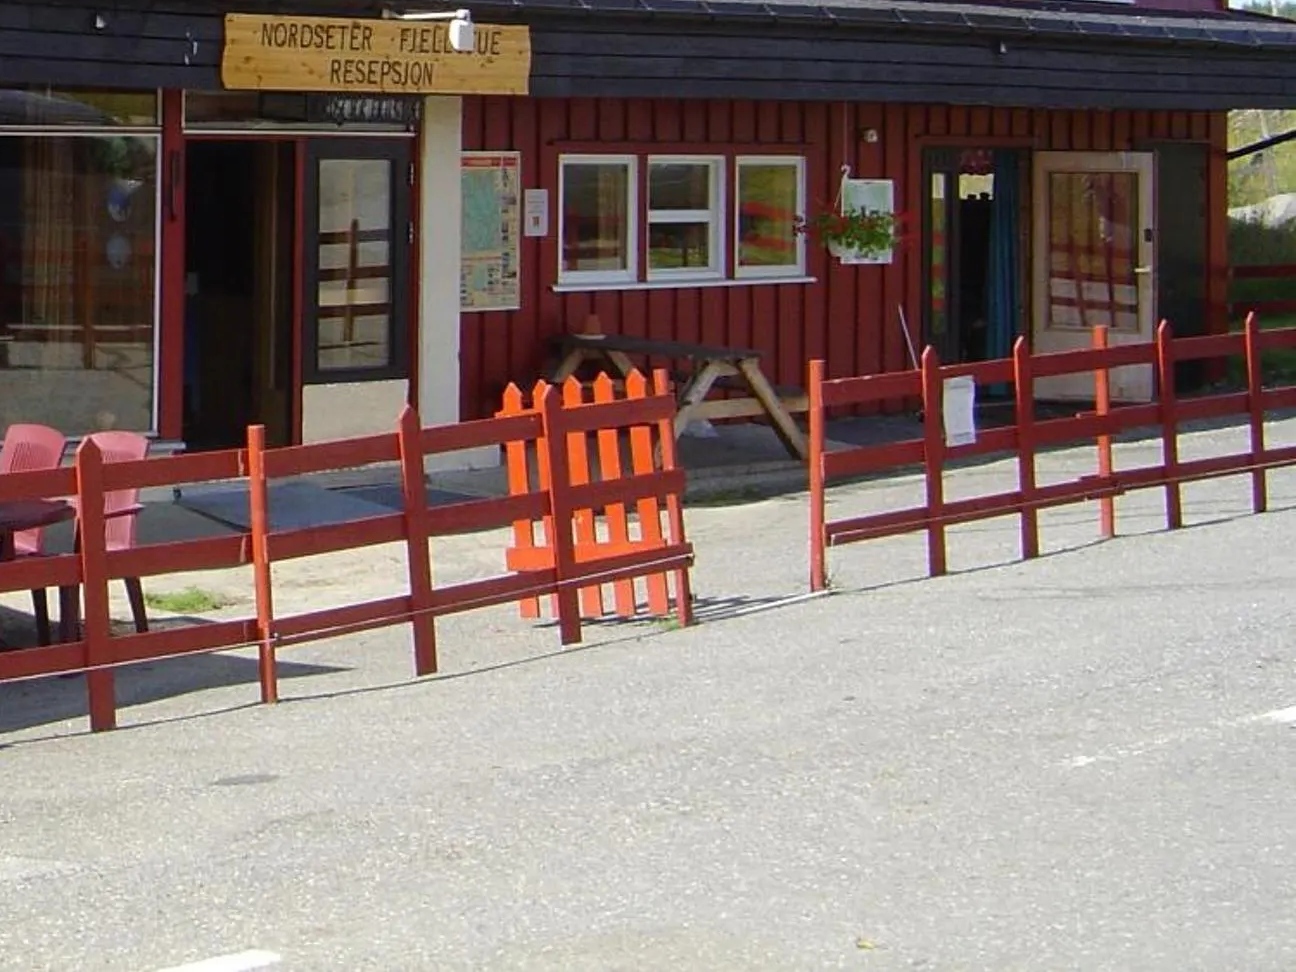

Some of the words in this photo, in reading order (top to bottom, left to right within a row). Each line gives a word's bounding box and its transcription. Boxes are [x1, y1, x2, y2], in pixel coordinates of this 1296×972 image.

[261, 23, 372, 51] NORDSETER
[400, 26, 501, 55] FJELLUE
[330, 59, 434, 86] RESEPSJON
